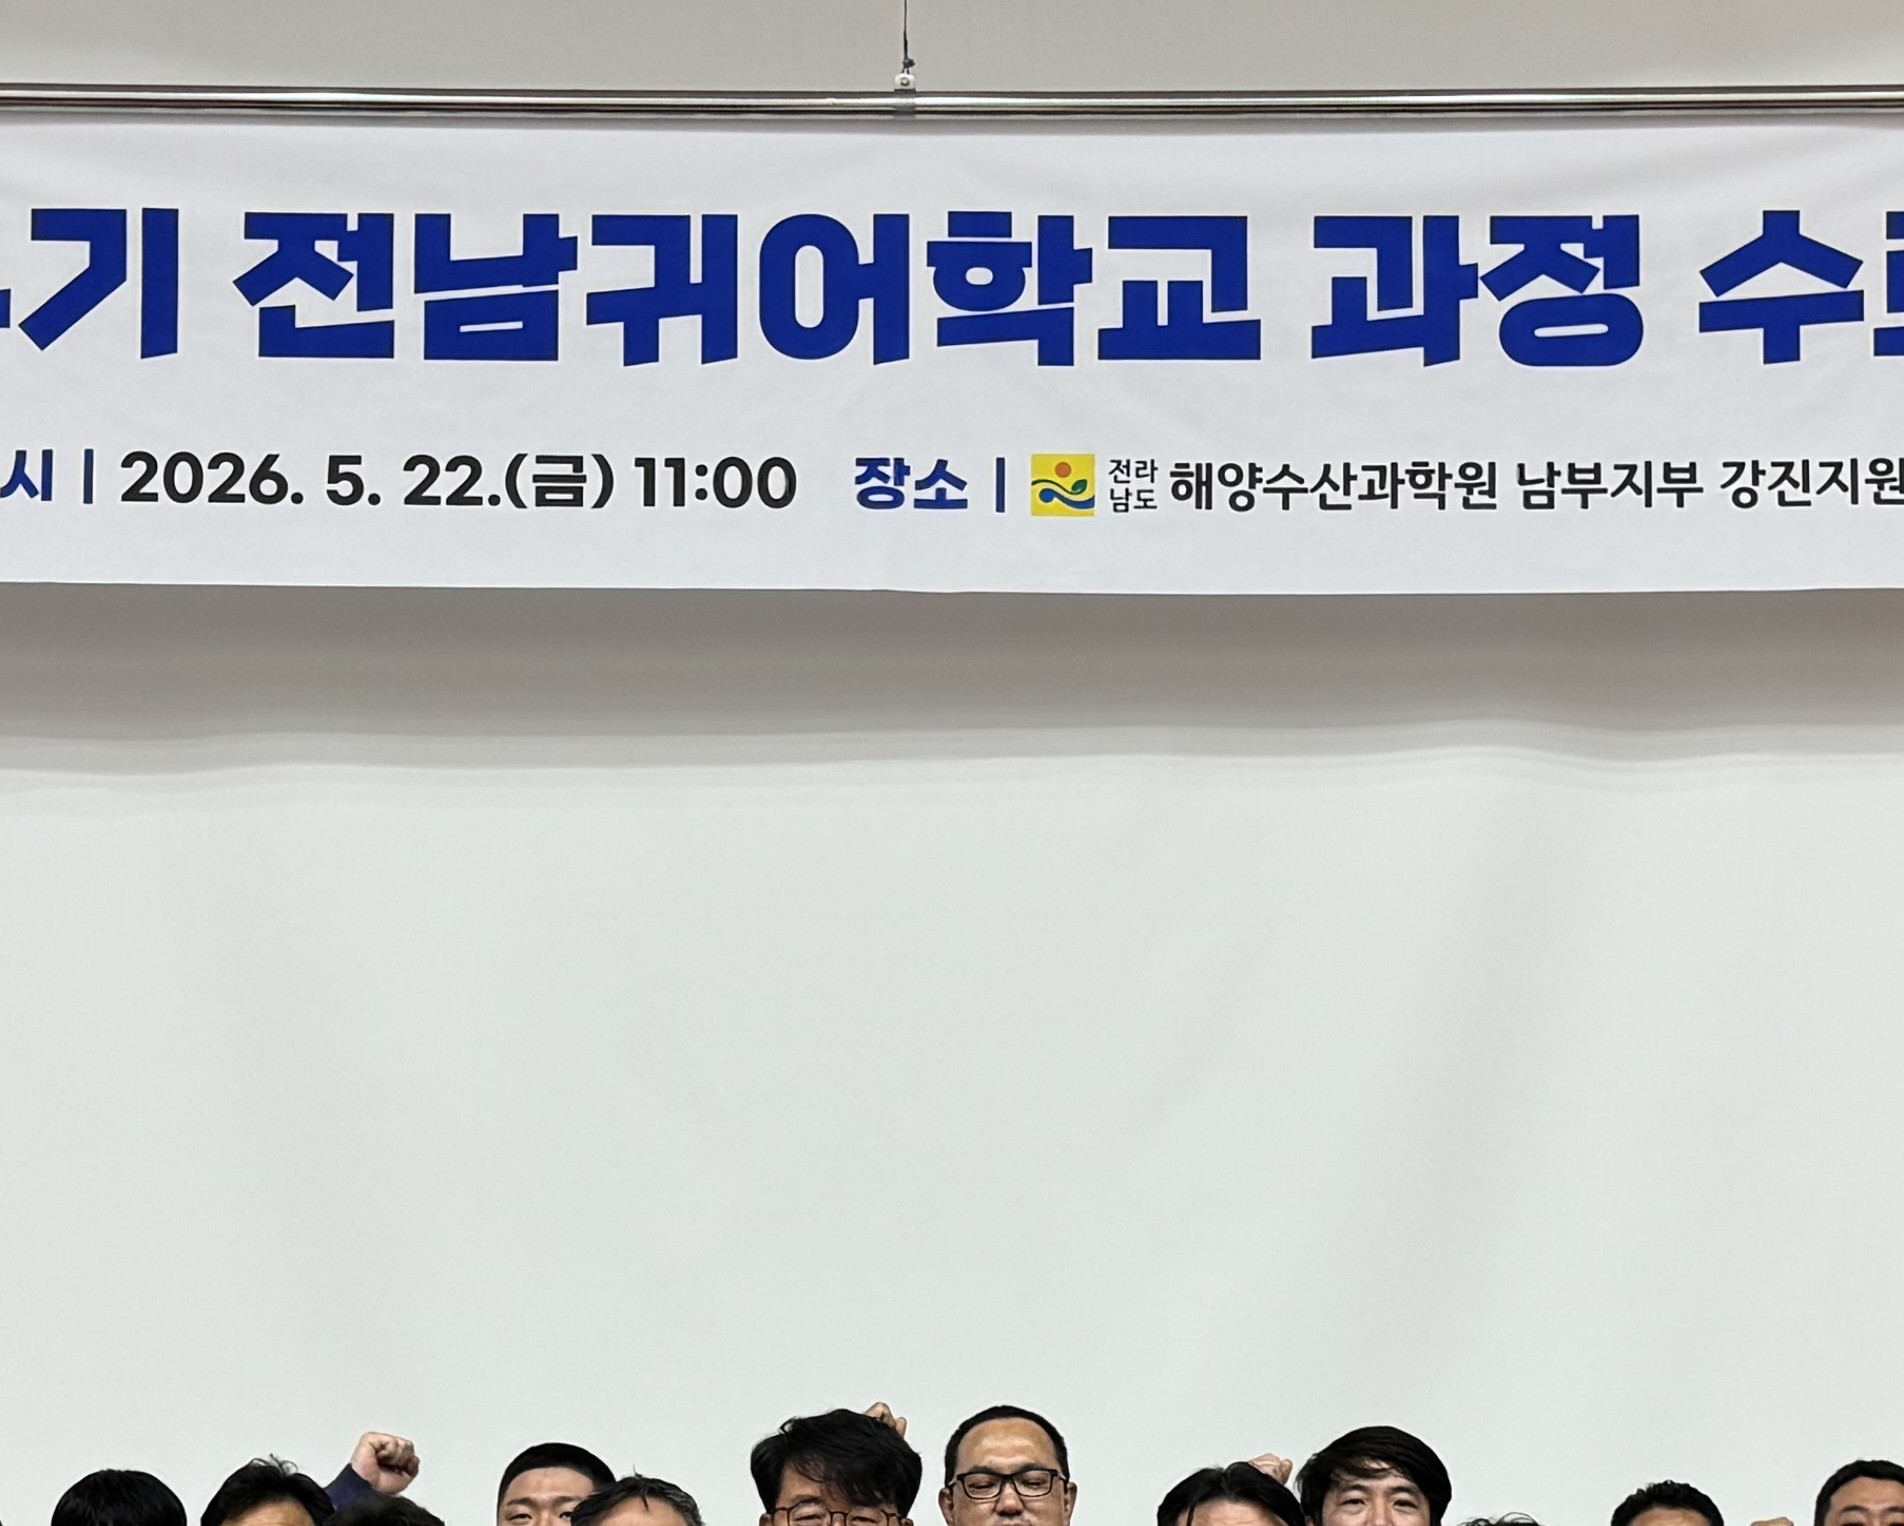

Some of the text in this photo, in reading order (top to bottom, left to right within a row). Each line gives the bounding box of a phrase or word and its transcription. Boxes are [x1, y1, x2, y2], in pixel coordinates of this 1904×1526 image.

[232, 210, 1262, 367] 전남귀어학교
[1311, 214, 1644, 367] 과정
[120, 450, 304, 505] 2026.
[326, 454, 381, 506] 5.
[402, 453, 614, 509] 22.(금)
[634, 456, 797, 509] 11:00
[854, 457, 969, 510] 장소
[1108, 458, 1159, 484] 전라
[1169, 461, 1497, 512] 해양수산과학원
[1517, 460, 1704, 510] 남부지부
[1108, 487, 1159, 513] 남도
